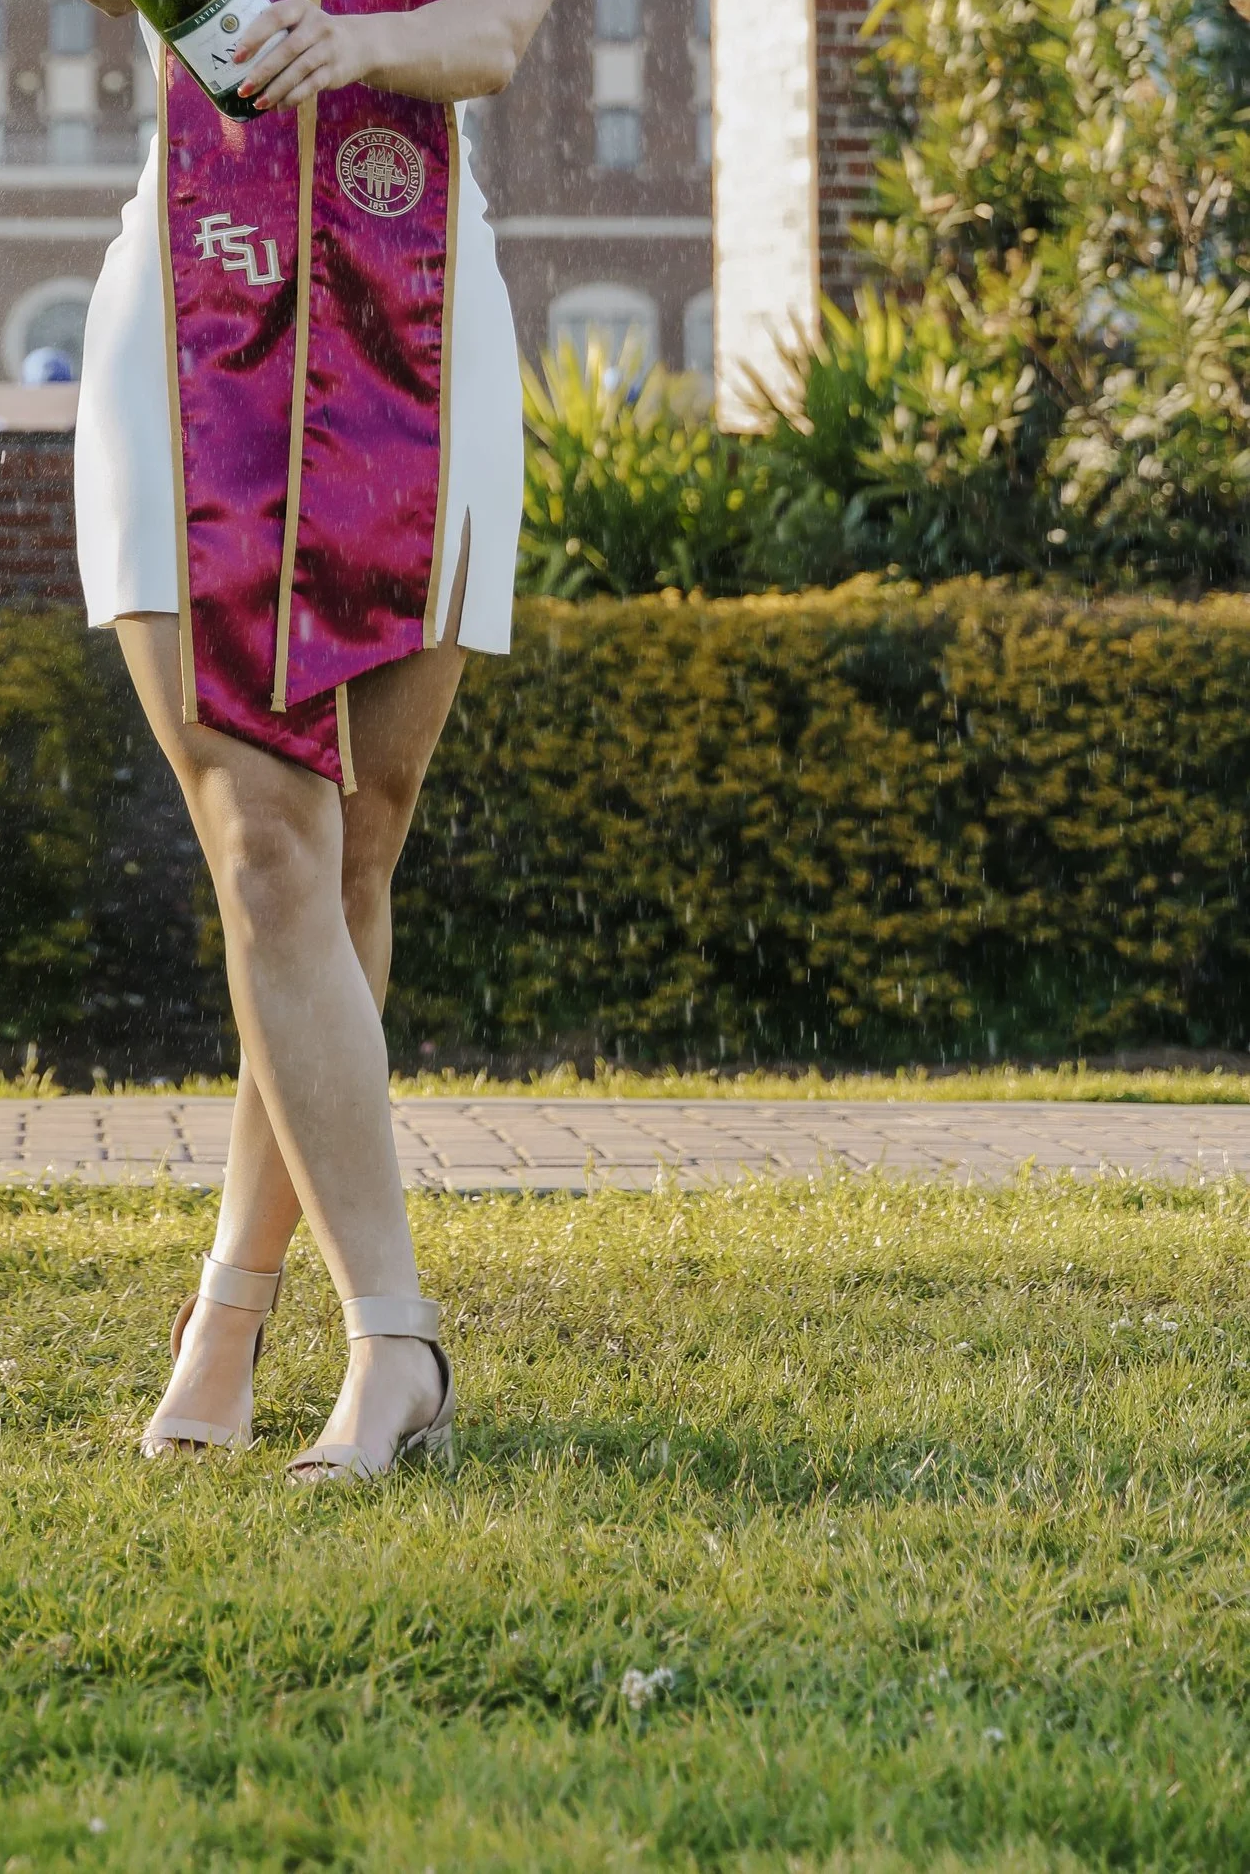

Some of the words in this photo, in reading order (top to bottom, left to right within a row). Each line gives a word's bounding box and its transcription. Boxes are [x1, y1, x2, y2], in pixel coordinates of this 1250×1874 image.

[194, 3, 221, 25] EXTRA
[341, 144, 359, 189] FLORIDA
[357, 133, 392, 146] STATE
[394, 139, 419, 203] UNIVERSITY
[367, 199, 390, 212] 1851
[193, 212, 287, 286] FSU
